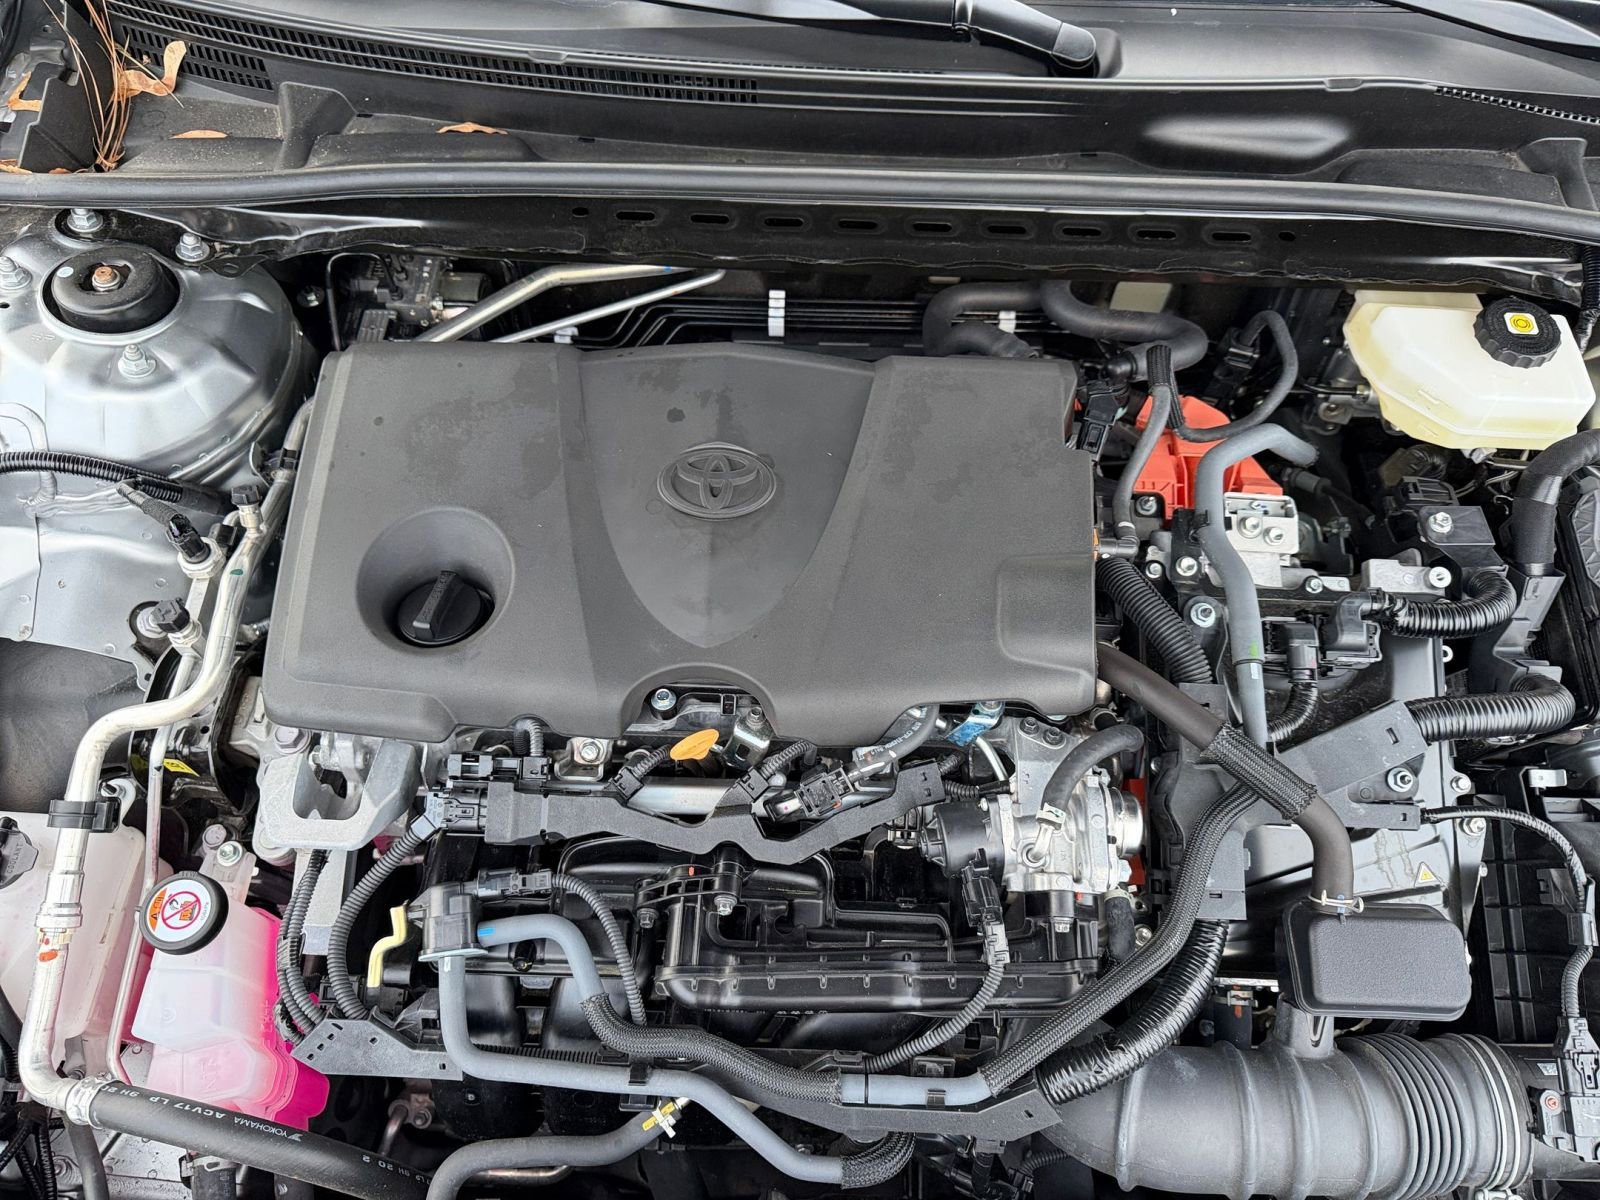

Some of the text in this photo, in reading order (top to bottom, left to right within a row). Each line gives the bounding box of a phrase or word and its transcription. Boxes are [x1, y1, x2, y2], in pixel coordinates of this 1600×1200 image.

[6, 843, 24, 874] COOLANT
[148, 1096, 170, 1105] LP
[173, 1103, 227, 1119] ACV17
[234, 1116, 288, 1138] YOKOHAMA
